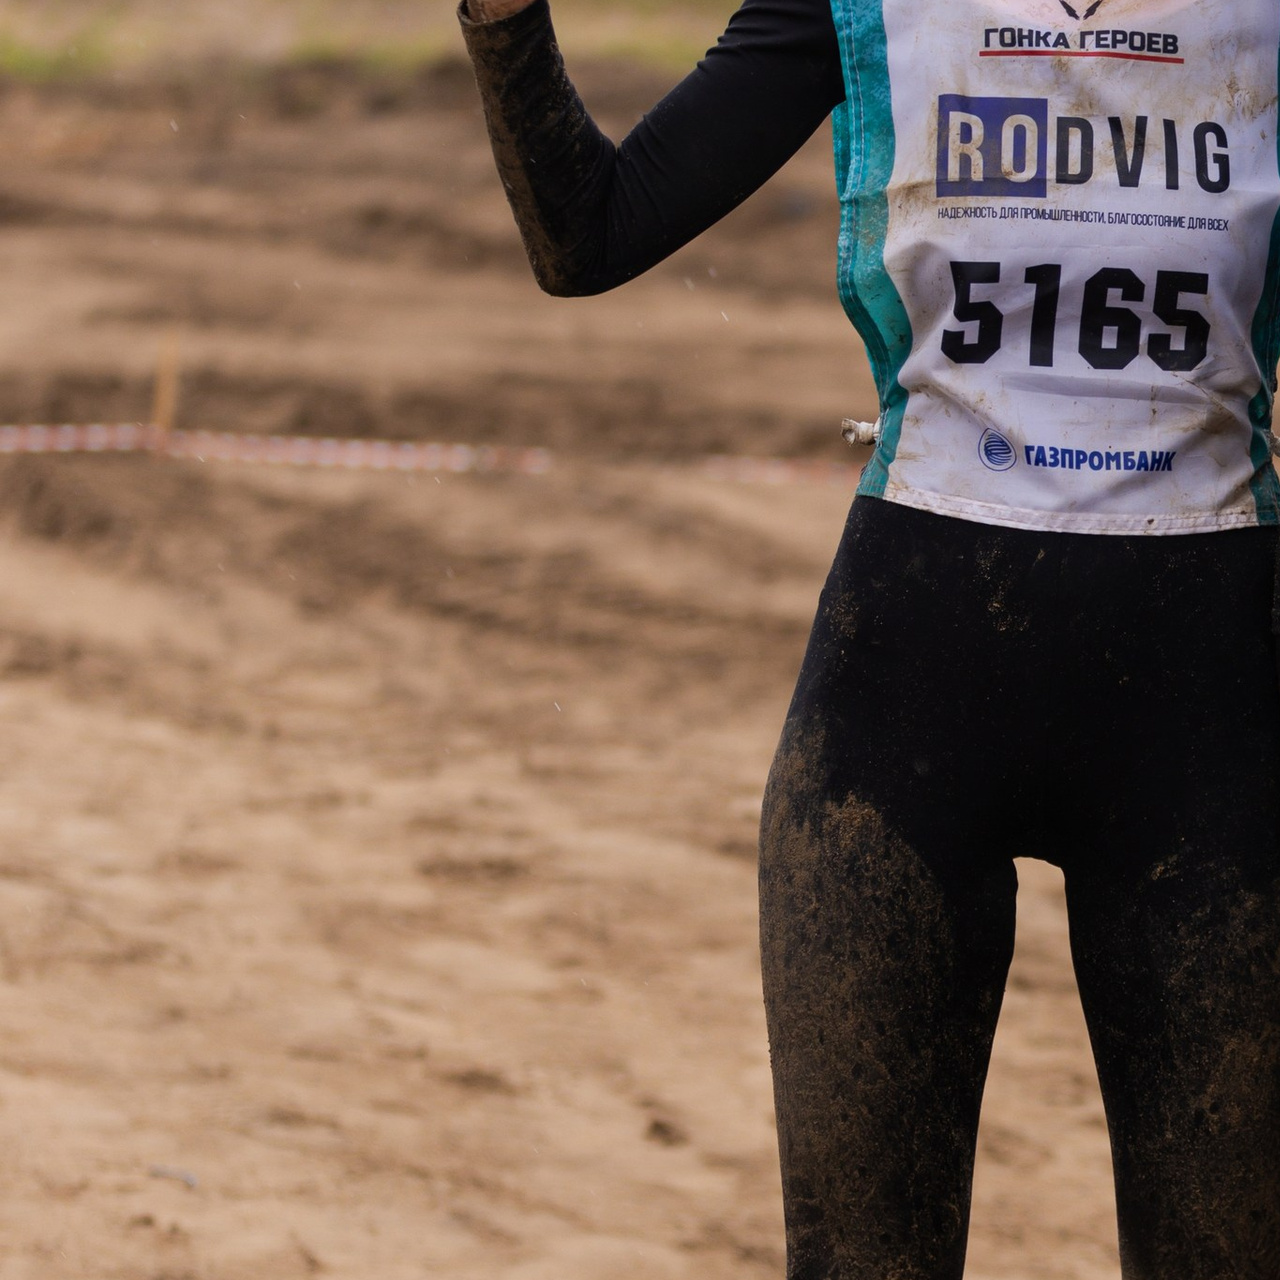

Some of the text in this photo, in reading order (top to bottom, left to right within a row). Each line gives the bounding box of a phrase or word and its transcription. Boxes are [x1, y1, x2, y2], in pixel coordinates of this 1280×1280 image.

[984, 27, 1179, 55] ГОНКА ГЕРОЕВ
[946, 110, 1231, 194] RODVIG
[937, 206, 998, 219] НАДЕЖНОСТЬ
[999, 206, 1019, 220] ДЛЯ
[1107, 212, 1186, 229] БЛАГОСОСТОЯНИЕ
[1187, 216, 1207, 230] ДЛЯ
[1207, 218, 1230, 232] ВСЕХ
[940, 261, 1210, 371] 5165
[1024, 445, 1177, 472] ГАЗПРОМБАНК
